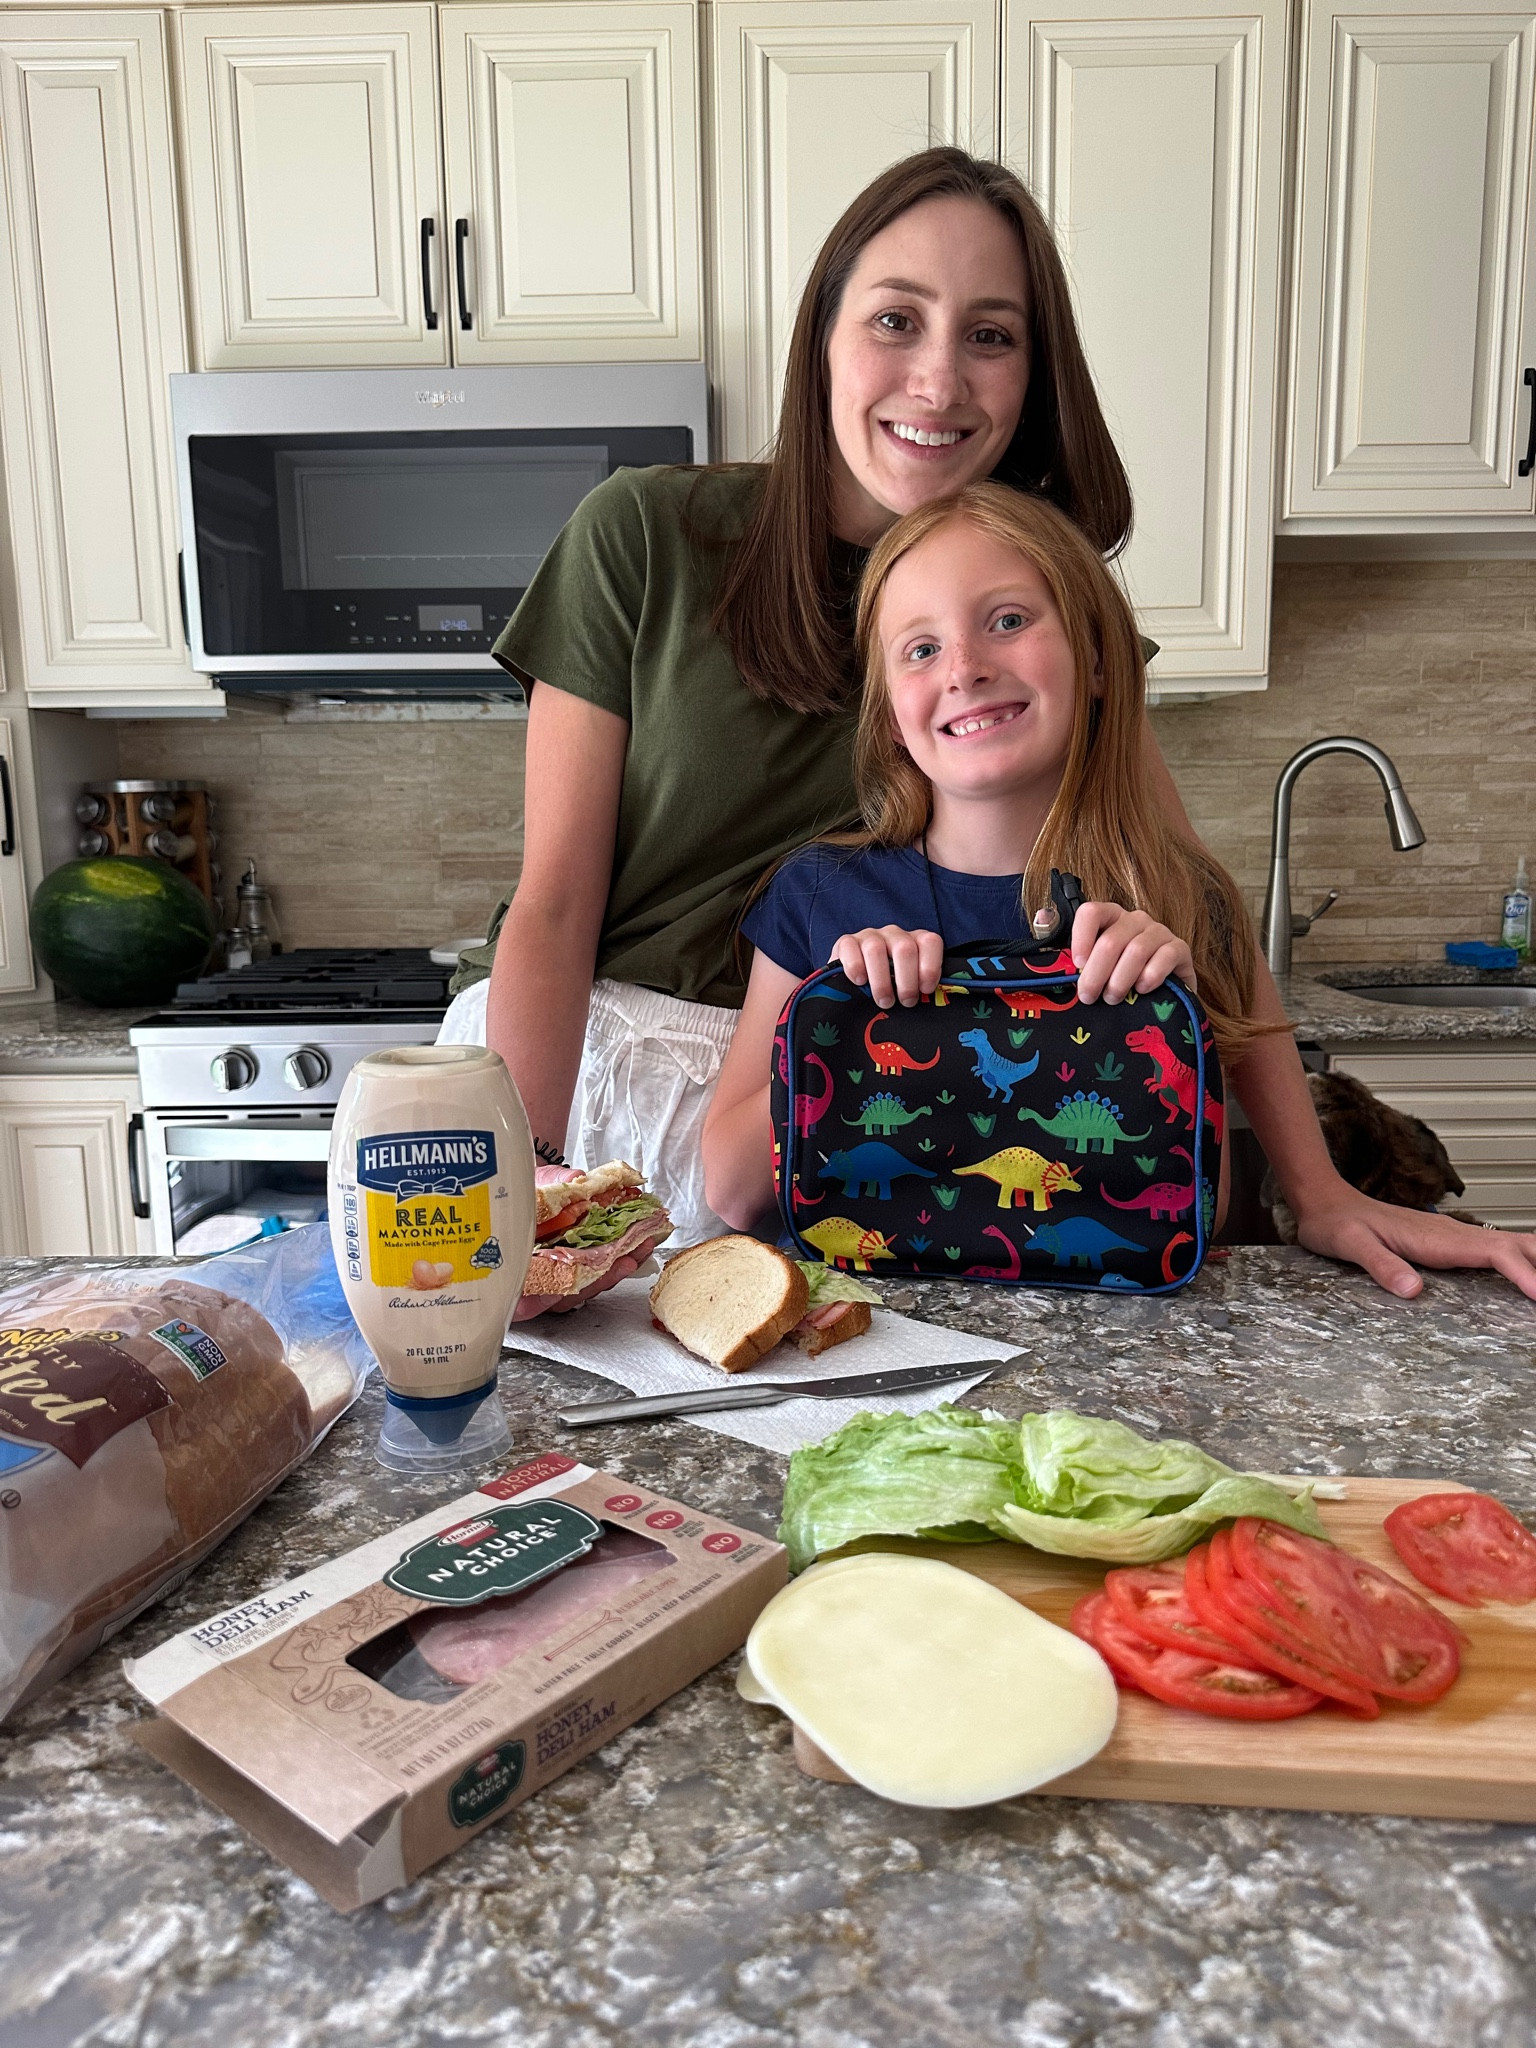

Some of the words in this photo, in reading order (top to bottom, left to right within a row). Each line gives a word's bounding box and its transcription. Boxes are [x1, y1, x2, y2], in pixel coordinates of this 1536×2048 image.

[1506, 903, 1527, 914] Dial
[365, 1136, 487, 1171] HELLMANN'S
[379, 1222, 480, 1239] MAYONNAISE
[396, 1206, 462, 1227] REAL
[405, 1240, 421, 1248] with
[422, 1239, 440, 1248] Cage
[441, 1238, 457, 1246] Free
[458, 1236, 475, 1244] Eggs
[480, 1248, 498, 1256] 100%
[161, 1331, 207, 1373] VERIFIED
[198, 1342, 219, 1367] GMO
[204, 1339, 224, 1363] NON
[406, 1348, 415, 1357] 20
[416, 1347, 424, 1356] FL
[426, 1346, 435, 1355] OZ
[436, 1345, 453, 1355] (1.25
[454, 1344, 466, 1353] PT)
[424, 1357, 435, 1365] 591
[500, 1463, 549, 1486] 100%
[500, 1462, 569, 1496] NATURAL
[611, 1497, 634, 1511] NO
[446, 1521, 486, 1543] Hormel
[653, 1513, 676, 1527] NO
[428, 1517, 562, 1583] NATURAL
[470, 1531, 557, 1575] CHOICE
[710, 1536, 733, 1551] NO
[615, 1588, 655, 1615] RESEALABLE
[655, 1576, 678, 1594] ZIPPER
[191, 1598, 269, 1641] HONEY
[202, 1618, 258, 1648] DELI
[258, 1590, 314, 1619] HAM
[534, 1674, 562, 1694] GLUTEN
[561, 1663, 582, 1679] FREE
[585, 1647, 607, 1663] FULLY
[605, 1629, 634, 1650] COOKED
[636, 1611, 660, 1630] SLICED
[662, 1599, 679, 1613] KEEP
[678, 1572, 722, 1601] REFRIGERATED
[536, 1697, 594, 1749] HONEY
[537, 1729, 575, 1766] DELI
[578, 1700, 616, 1737] HAM
[401, 1759, 425, 1778] NET
[420, 1748, 443, 1765] WT
[437, 1743, 451, 1754] 8
[445, 1732, 463, 1749] OZ
[459, 1760, 517, 1805] NATURAL
[470, 1775, 508, 1807] CHOICE
